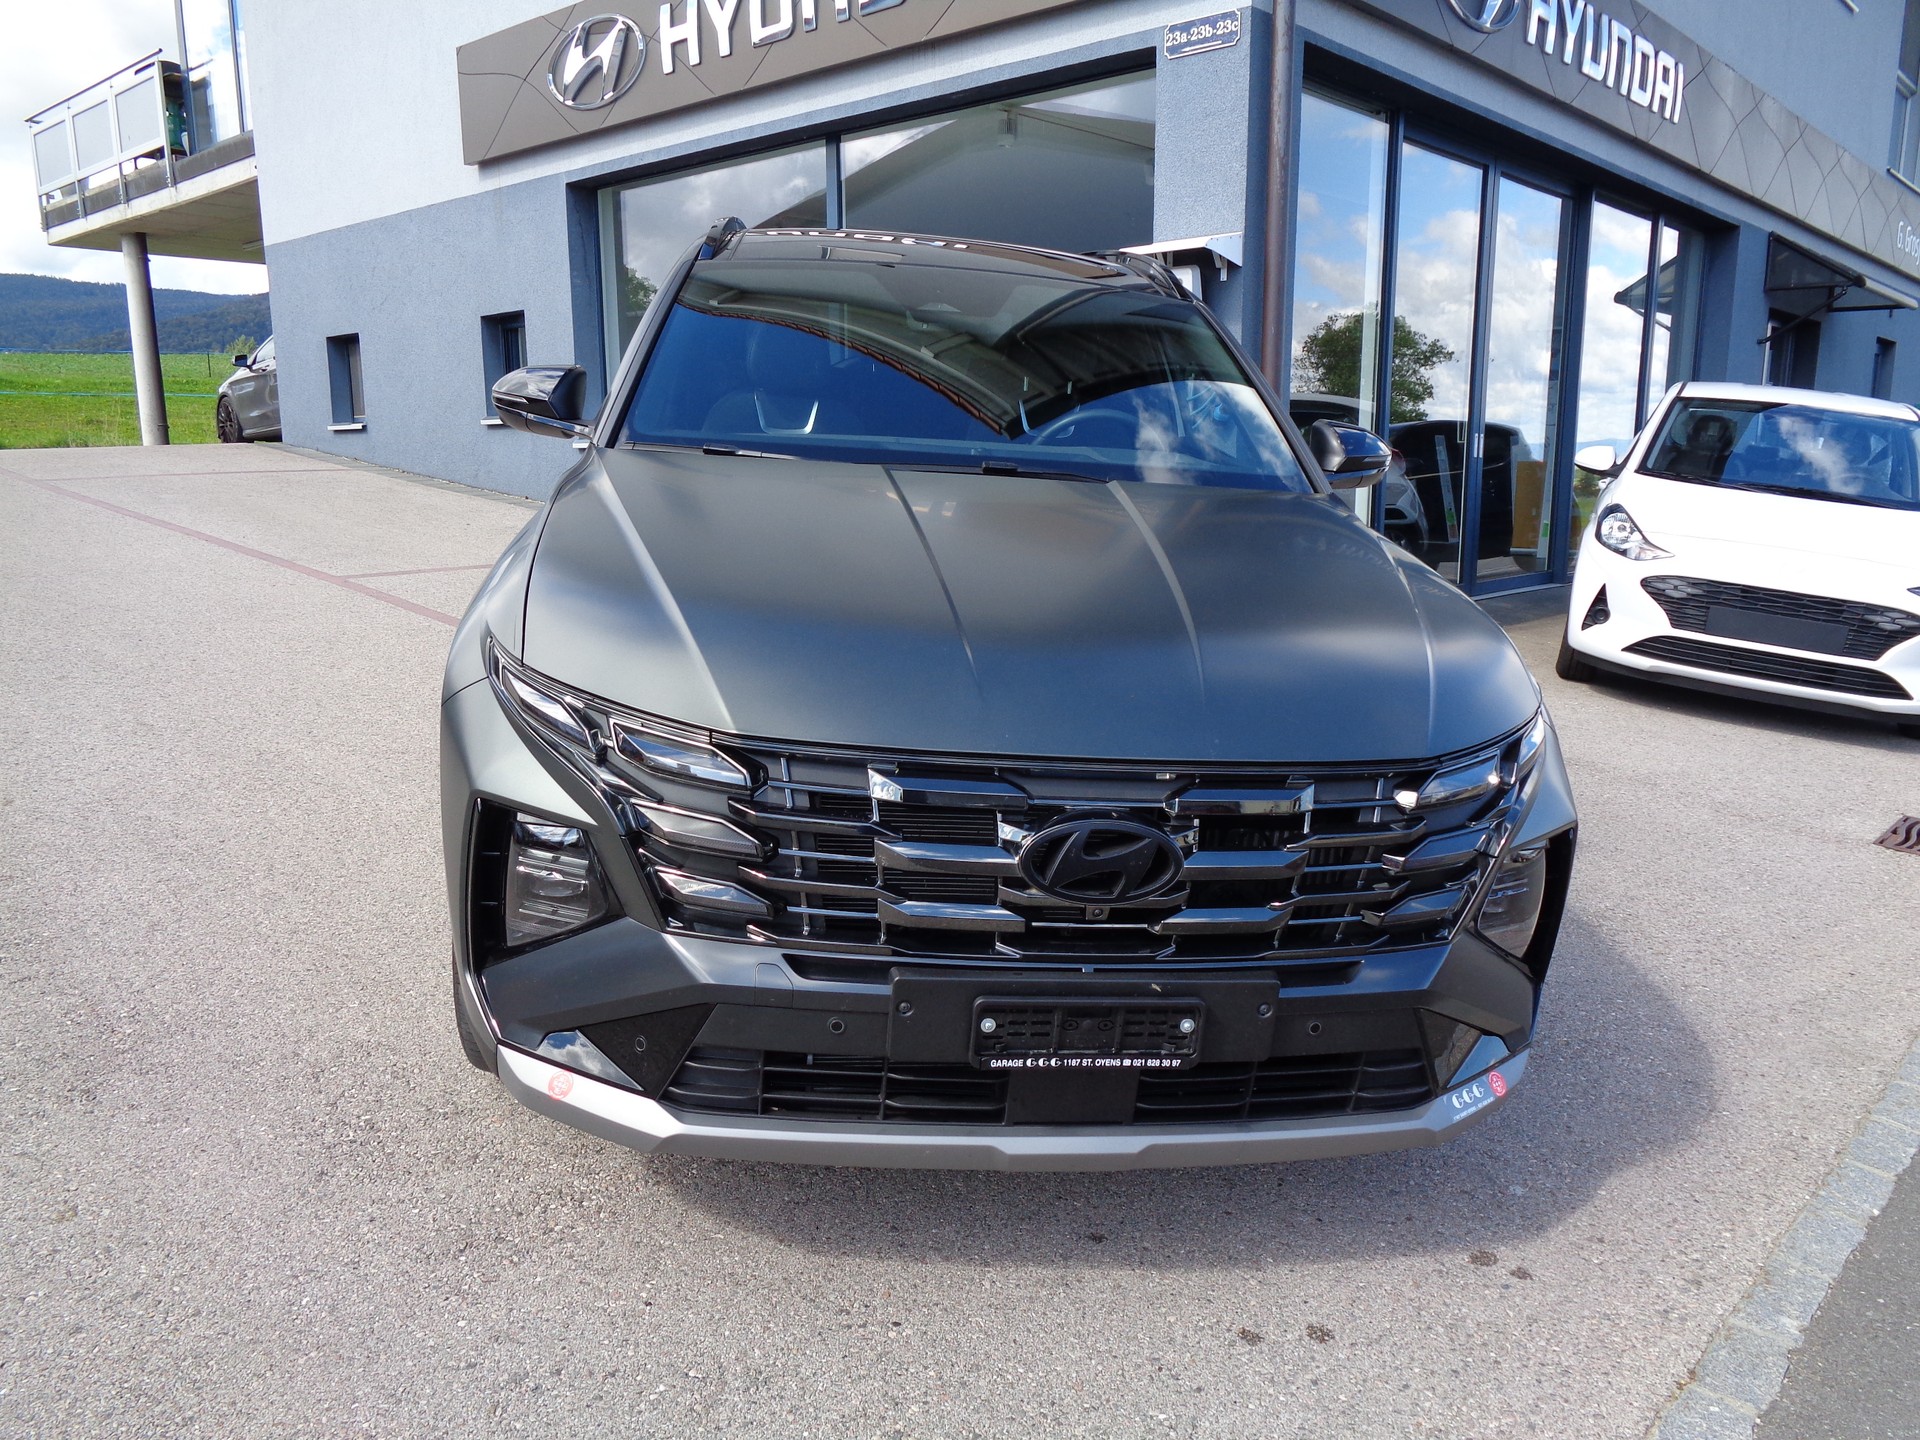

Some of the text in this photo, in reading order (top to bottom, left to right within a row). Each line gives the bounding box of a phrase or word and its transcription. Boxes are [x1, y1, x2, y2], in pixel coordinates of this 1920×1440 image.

[1525, 0, 1685, 124] HYUNDAI
[990, 1059, 1024, 1068] GARAGE
[1081, 1058, 1094, 1067] ST.
[1095, 1058, 1121, 1067] OYENS
[1132, 1058, 1146, 1067] 021
[1146, 1058, 1160, 1067] 828
[1161, 1059, 1171, 1067] 30
[1171, 1059, 1181, 1067] 97
